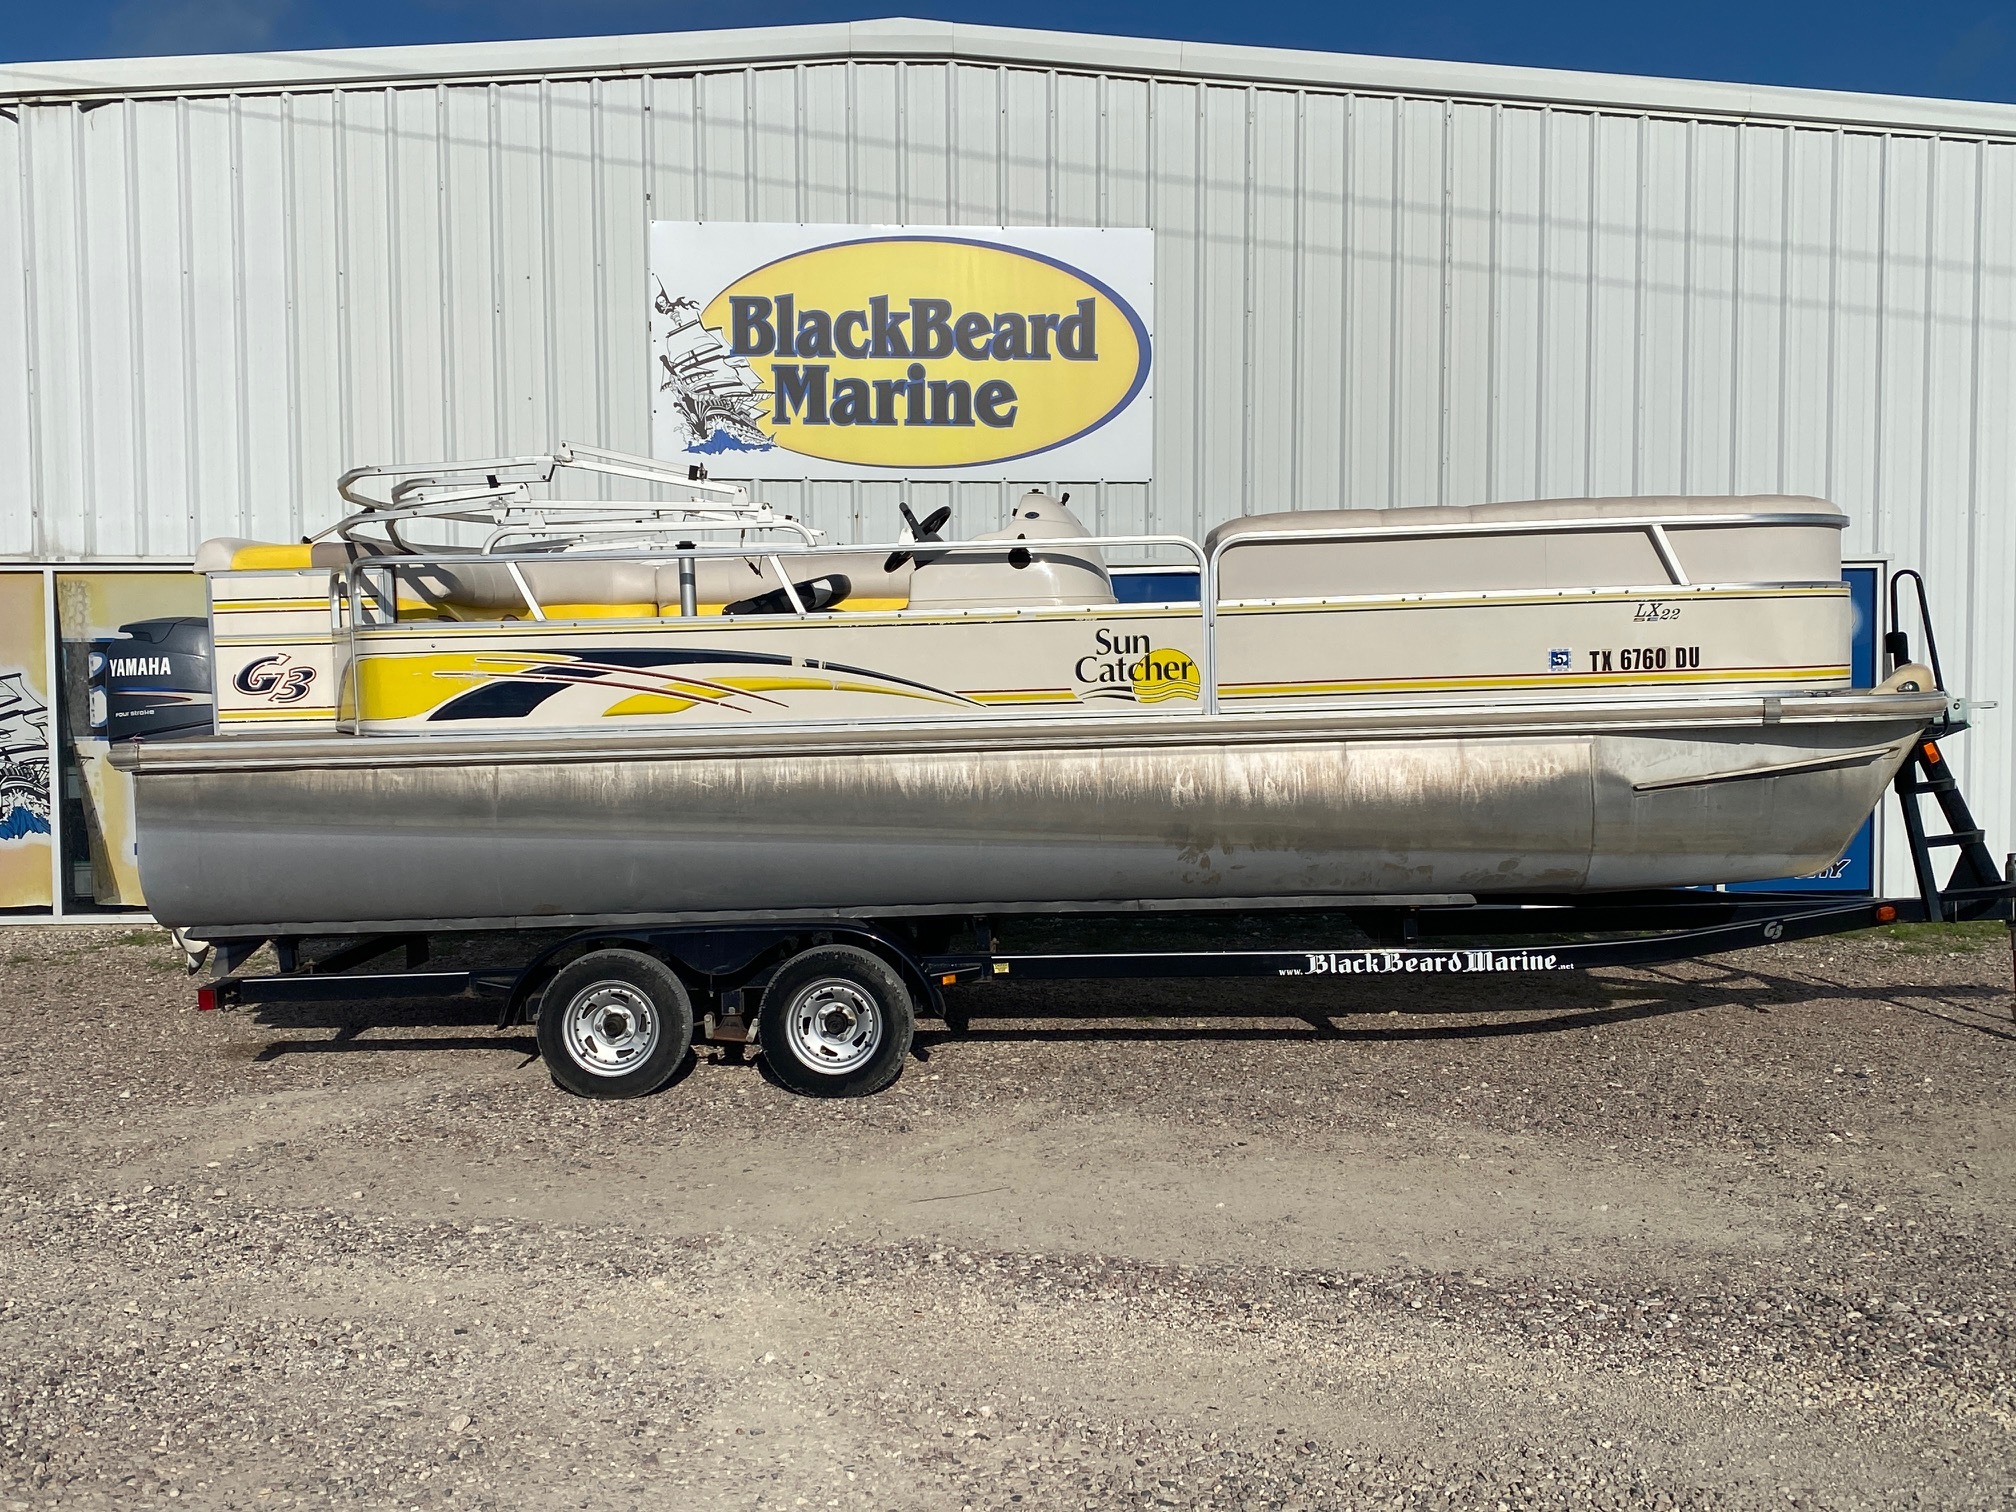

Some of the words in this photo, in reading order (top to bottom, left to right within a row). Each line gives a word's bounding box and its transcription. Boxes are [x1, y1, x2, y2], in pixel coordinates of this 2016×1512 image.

[729, 293, 1099, 361] BlackBeard
[771, 362, 1018, 428] Marine
[1095, 628, 1150, 656] Sun
[109, 656, 171, 677] YAMAHA
[1075, 653, 1193, 683] Catcher
[1589, 650, 1612, 672] TX
[1620, 648, 1667, 670] 6760
[1675, 646, 1700, 668] DU
[232, 652, 317, 703] G3
